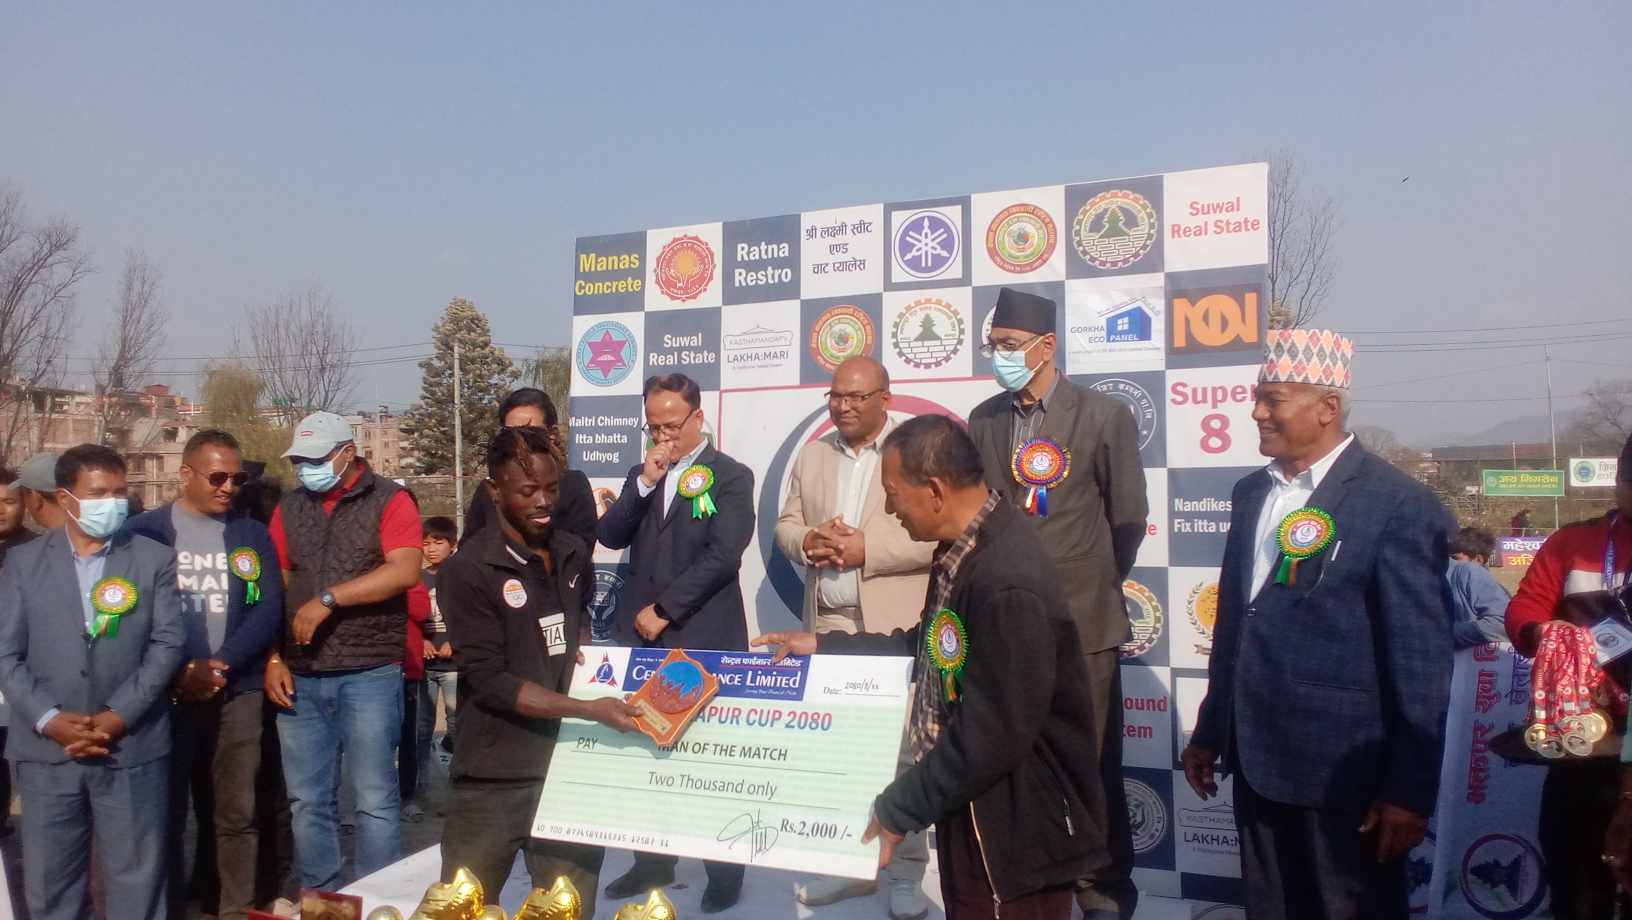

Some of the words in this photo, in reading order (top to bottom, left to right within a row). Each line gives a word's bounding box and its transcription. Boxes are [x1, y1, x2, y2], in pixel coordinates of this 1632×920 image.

[1189, 197, 1241, 216] Suwal
[806, 224, 817, 240] श्री
[1171, 222, 1208, 239] Real
[1213, 217, 1260, 235] State
[736, 241, 789, 262] Ratna
[579, 252, 640, 273] Manas
[575, 277, 642, 296] Concrete
[734, 267, 792, 288] Restro
[1070, 326, 1105, 334] GORKHA
[1110, 334, 1137, 342] PANEL
[663, 333, 702, 348] Suwal
[650, 351, 678, 366] Real
[681, 351, 716, 365] State
[727, 350, 789, 363] LAKHA:MARI
[598, 416, 639, 429] Chimney
[575, 433, 593, 444] Itta
[595, 432, 628, 444] bhatta
[1200, 413, 1232, 454] 8
[583, 451, 620, 463] Udhyog
[1174, 518, 1191, 533] Fix
[1194, 518, 1216, 533] itta
[178, 551, 228, 571] ONE
[717, 673, 743, 686] NCE
[745, 708, 781, 728] CUP
[785, 710, 832, 731] 2080
[577, 736, 599, 749] PAY
[692, 742, 711, 755] OF
[712, 743, 737, 757] THE
[739, 745, 788, 761] MATCH
[648, 771, 675, 788] Two
[679, 773, 745, 794] Thousand
[747, 779, 777, 798] only
[780, 819, 838, 840] Rs.2,000
